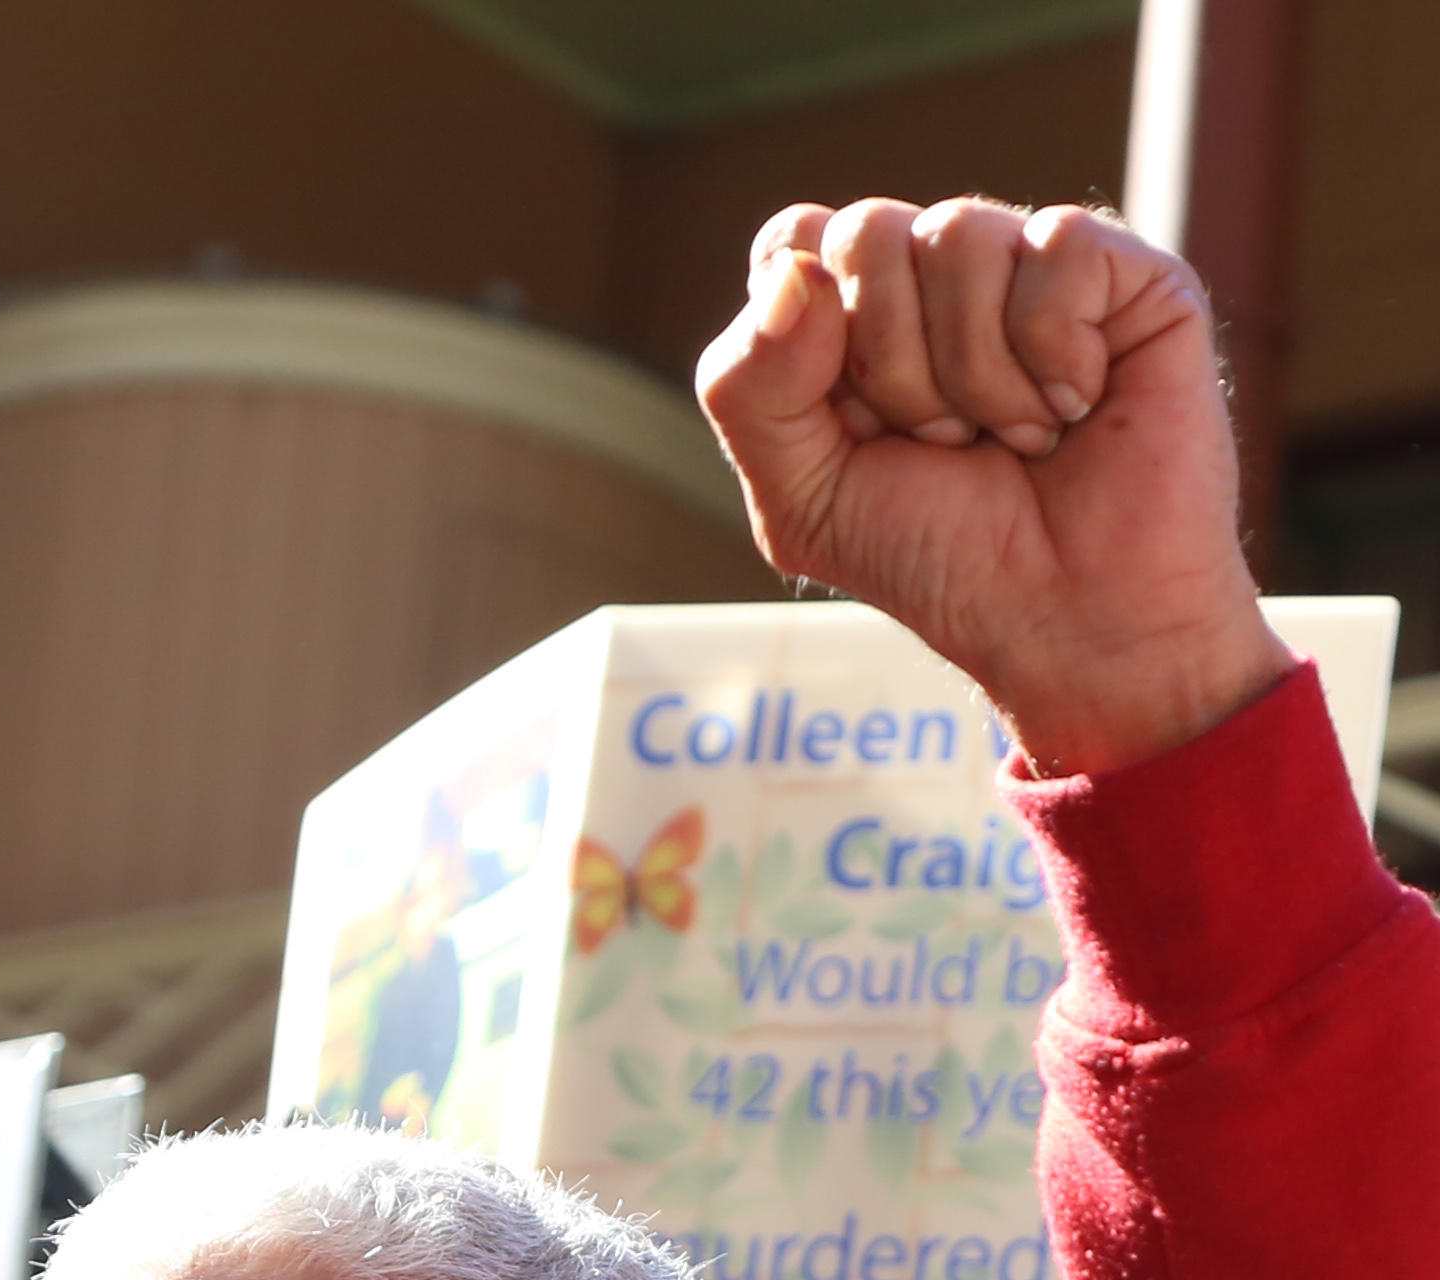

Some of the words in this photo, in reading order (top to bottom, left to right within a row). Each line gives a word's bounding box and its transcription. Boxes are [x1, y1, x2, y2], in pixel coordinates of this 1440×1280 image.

[628, 690, 957, 767] Colleen
[825, 815, 1046, 910] Craig
[736, 935, 981, 1007] Would
[1002, 936, 1062, 1006] b
[689, 1052, 781, 1122] 42
[806, 1047, 943, 1122] this
[967, 1070, 1046, 1139] ye
